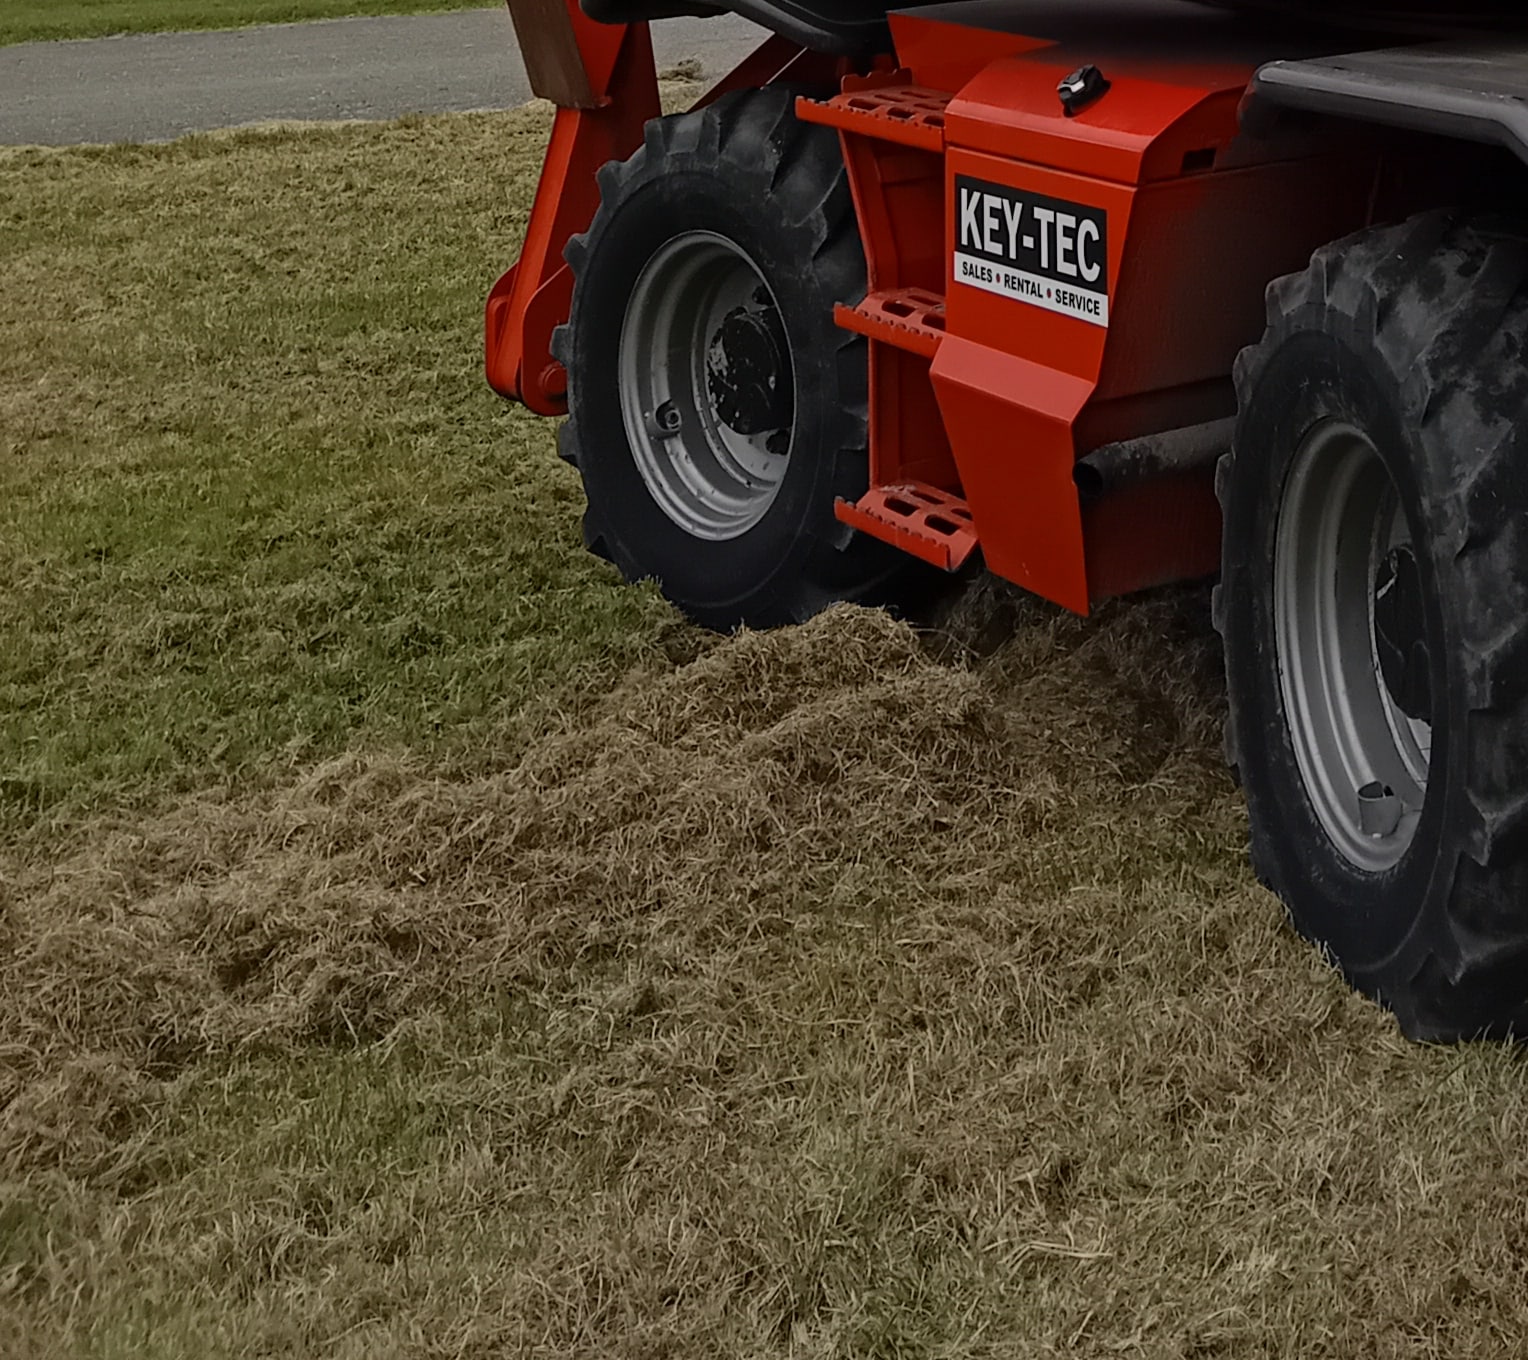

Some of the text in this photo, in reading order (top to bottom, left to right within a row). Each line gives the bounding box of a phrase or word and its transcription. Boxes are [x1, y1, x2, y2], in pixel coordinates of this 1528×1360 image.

[960, 187, 1100, 282] KEY-TEC
[962, 261, 1100, 316] SALES RENTAL SERVICE
